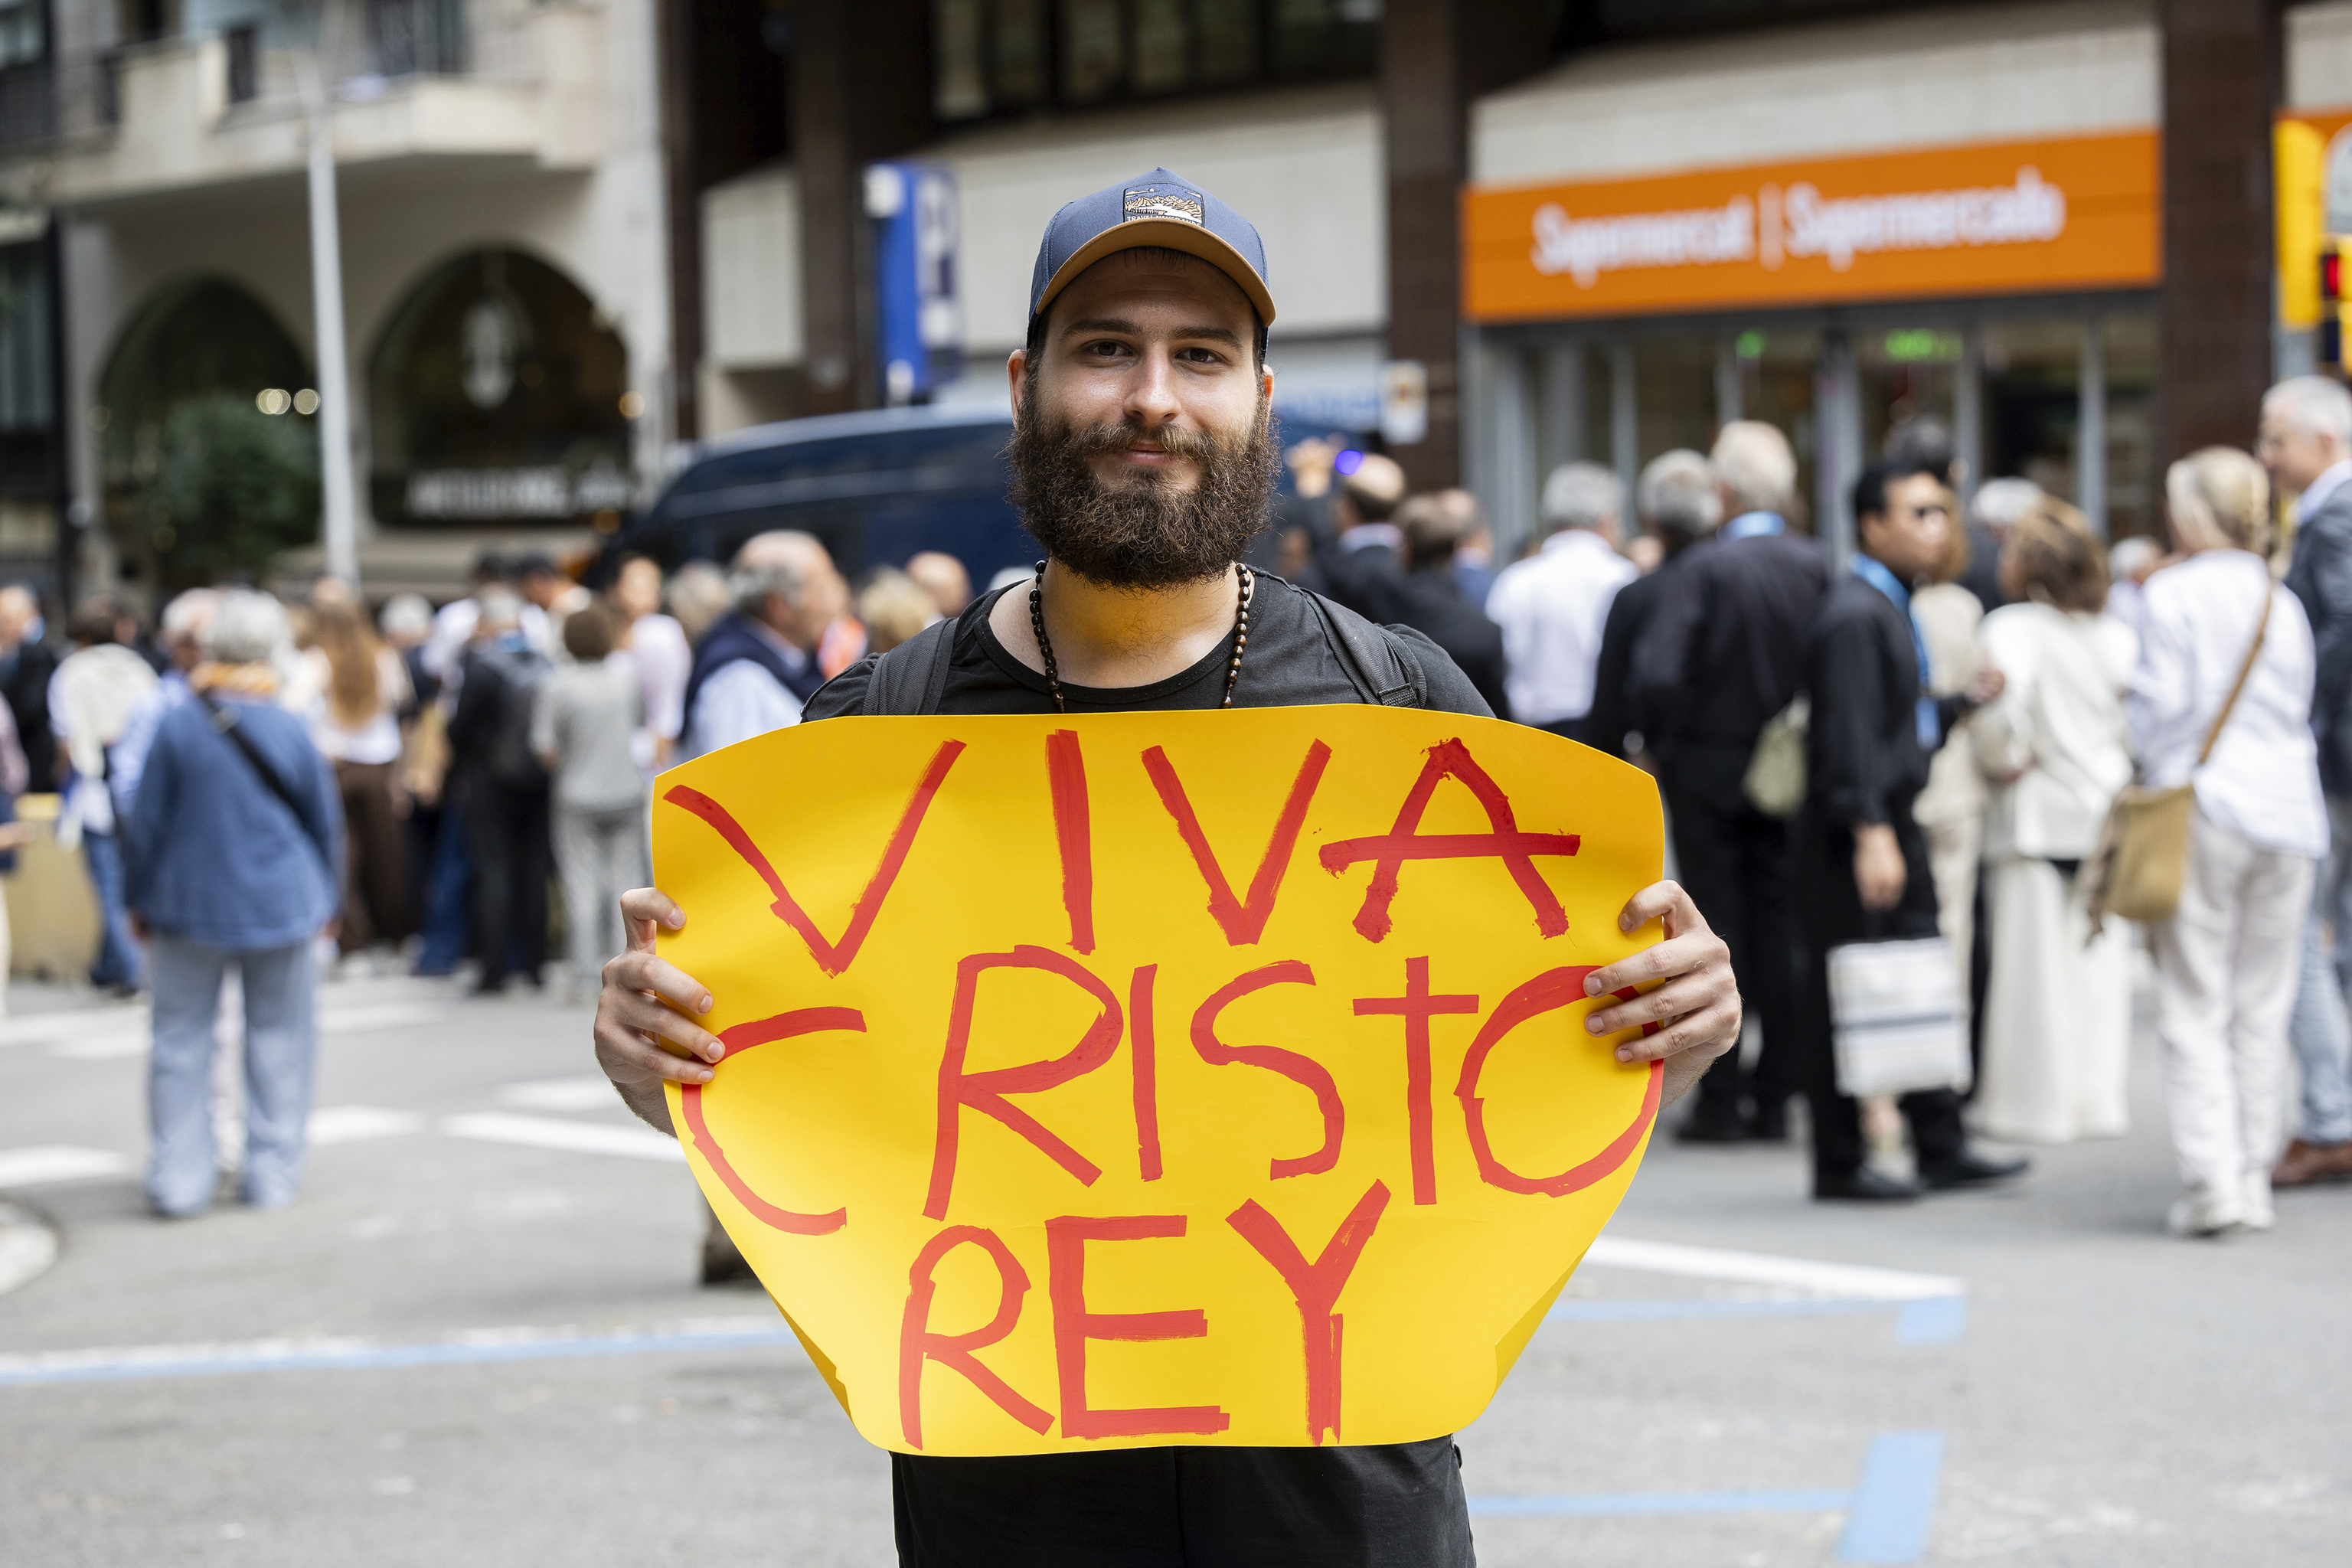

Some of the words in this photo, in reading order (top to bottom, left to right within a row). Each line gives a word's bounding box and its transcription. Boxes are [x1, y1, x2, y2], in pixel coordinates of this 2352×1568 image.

[664, 730, 1581, 978] VIVA
[681, 945, 1664, 1235] CRISTO
[899, 1180, 1391, 1449] REY
